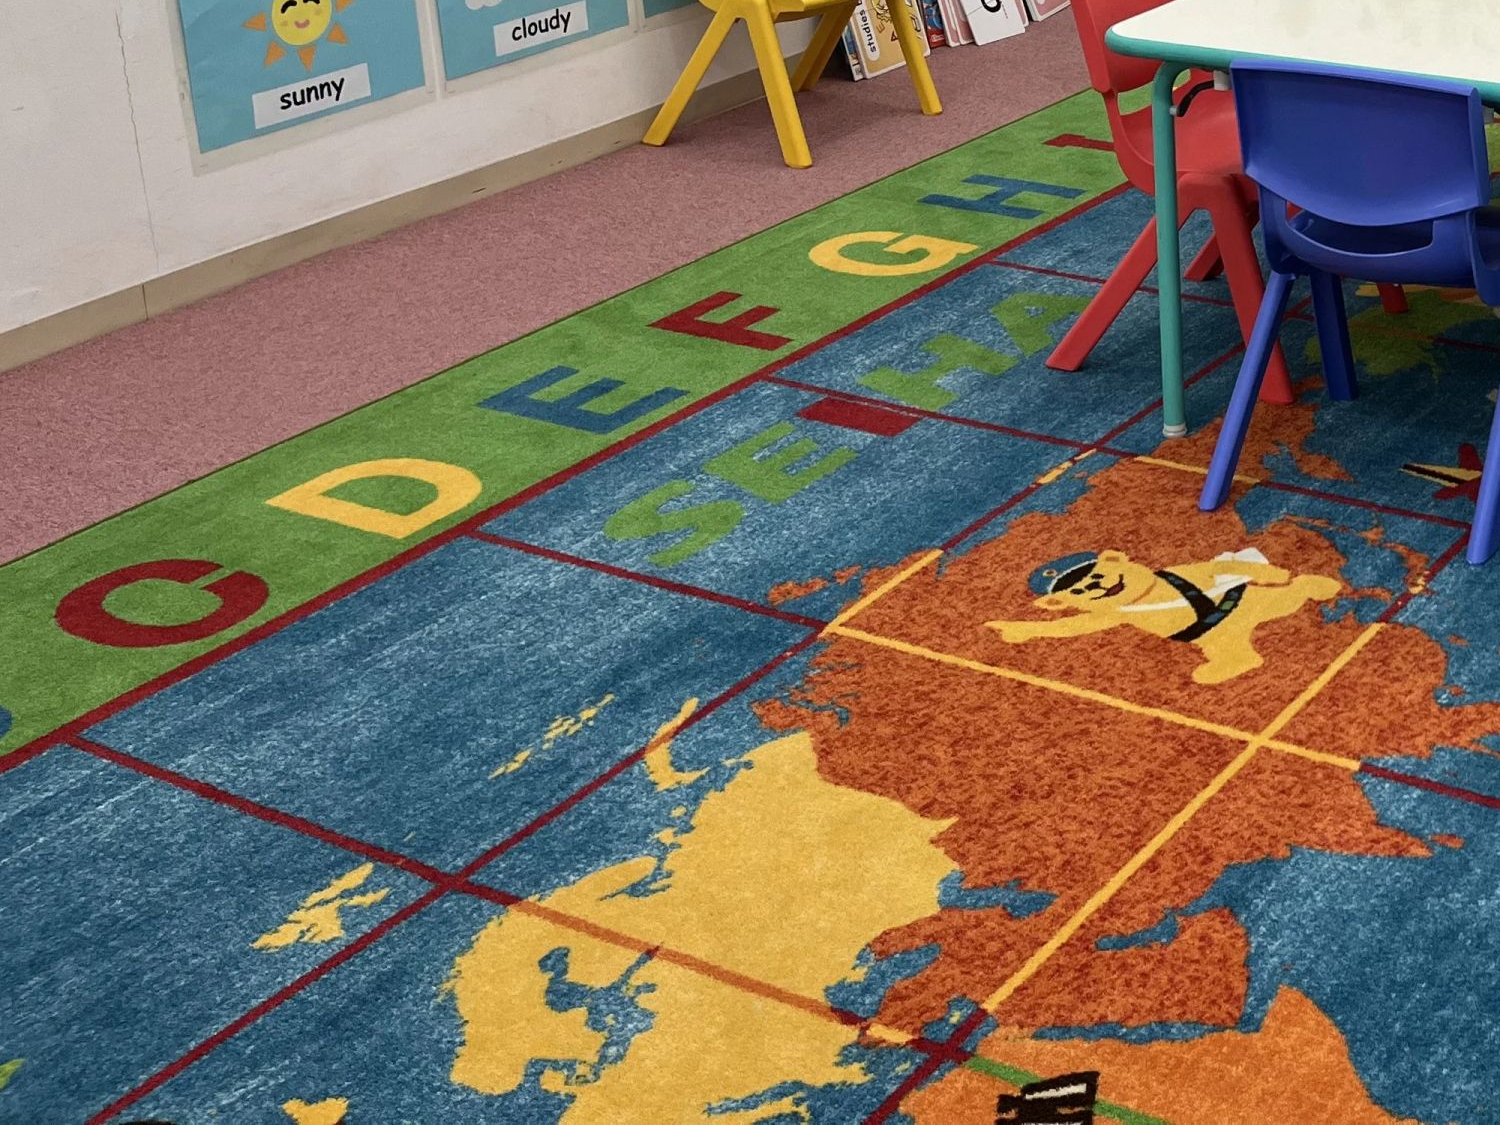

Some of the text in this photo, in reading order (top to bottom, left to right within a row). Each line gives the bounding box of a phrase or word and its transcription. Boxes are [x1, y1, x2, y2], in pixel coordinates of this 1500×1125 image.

[511, 9, 571, 41] cloudy
[859, 9, 877, 53] studies
[280, 78, 345, 110] sunny
[54, 558, 270, 648] C
[264, 457, 483, 539] D
[473, 365, 689, 434] E
[647, 290, 797, 352] F
[806, 229, 983, 278] G
[920, 174, 1086, 219] H
